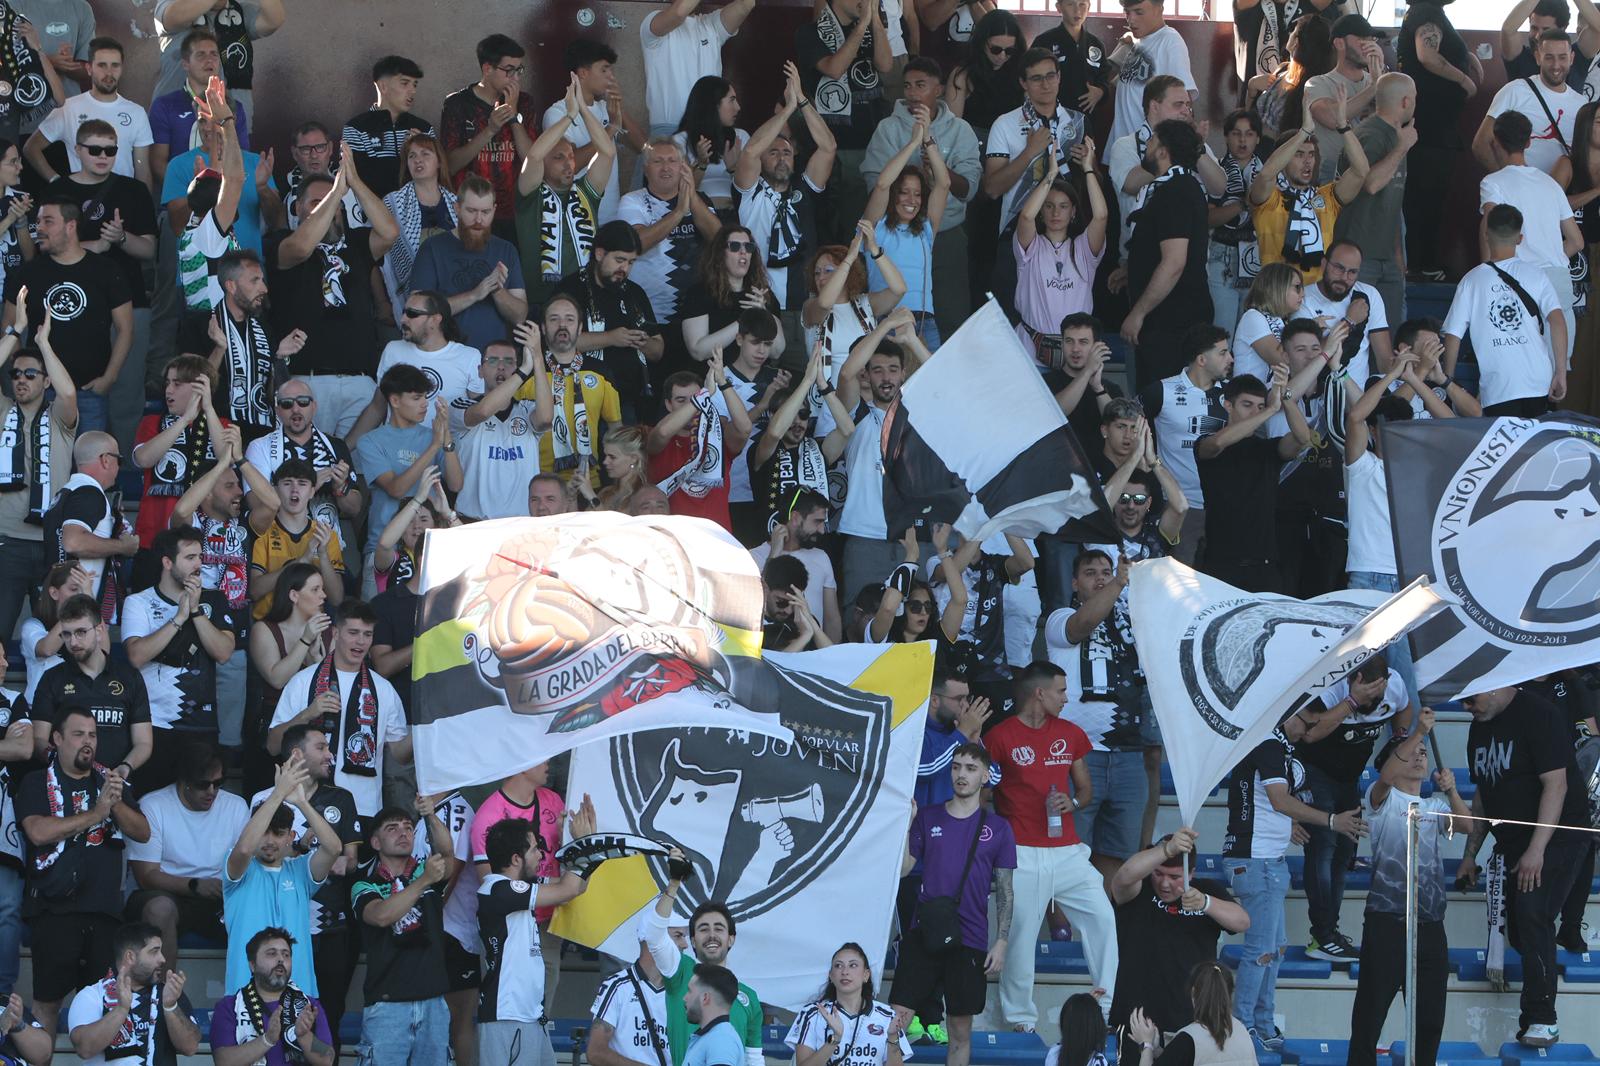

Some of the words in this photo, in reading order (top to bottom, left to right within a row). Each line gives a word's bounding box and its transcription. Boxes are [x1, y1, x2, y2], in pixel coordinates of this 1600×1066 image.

[491, 151, 514, 162] BETTER
[681, 223, 695, 234] QR
[1491, 284, 1511, 293] CAS
[1450, 573, 1460, 586] IN
[1457, 587, 1495, 630] MEMORIAM
[1498, 626, 1515, 639] VDS
[518, 679, 541, 704] LA
[547, 656, 608, 699] GRADA
[607, 633, 639, 664] DEL
[91, 709, 124, 724] TAPAS
[802, 735, 861, 753] POPVLAR
[751, 734, 858, 774] JOVEN
[1239, 780, 1249, 821] GUINALDO
[1492, 898, 1500, 926] DICEN
[634, 1032, 651, 1046] del
